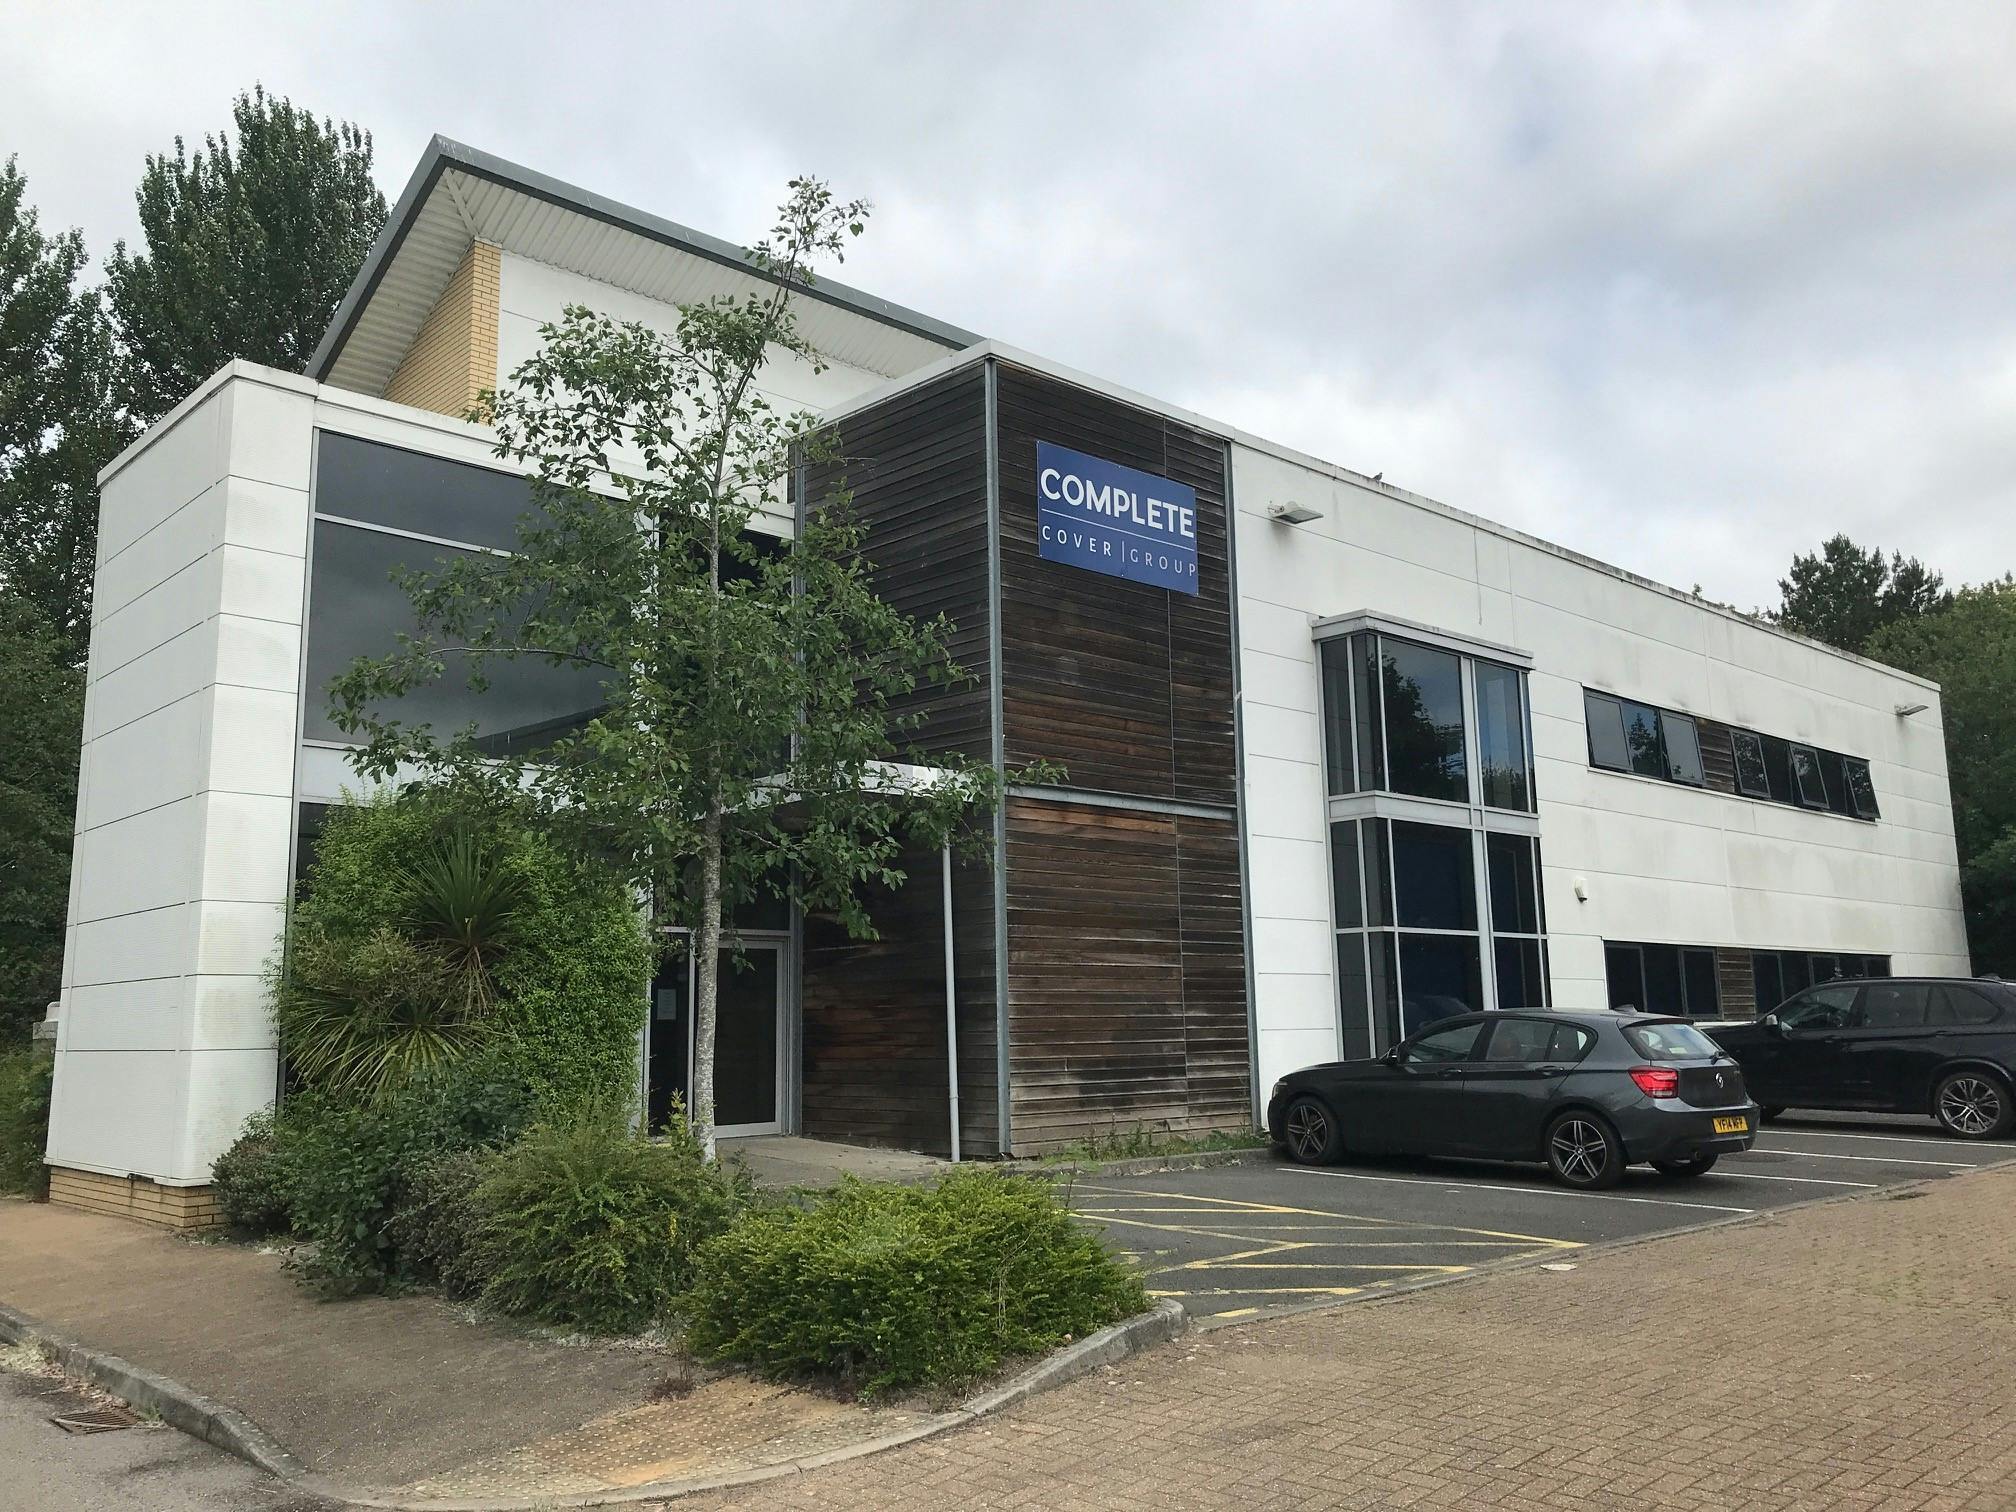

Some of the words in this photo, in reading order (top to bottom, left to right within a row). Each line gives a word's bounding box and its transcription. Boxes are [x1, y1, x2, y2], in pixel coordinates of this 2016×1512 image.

[1040, 468, 1194, 538] COMPLETE
[1042, 525, 1111, 556] COVER
[1130, 549, 1196, 577] GROUP
